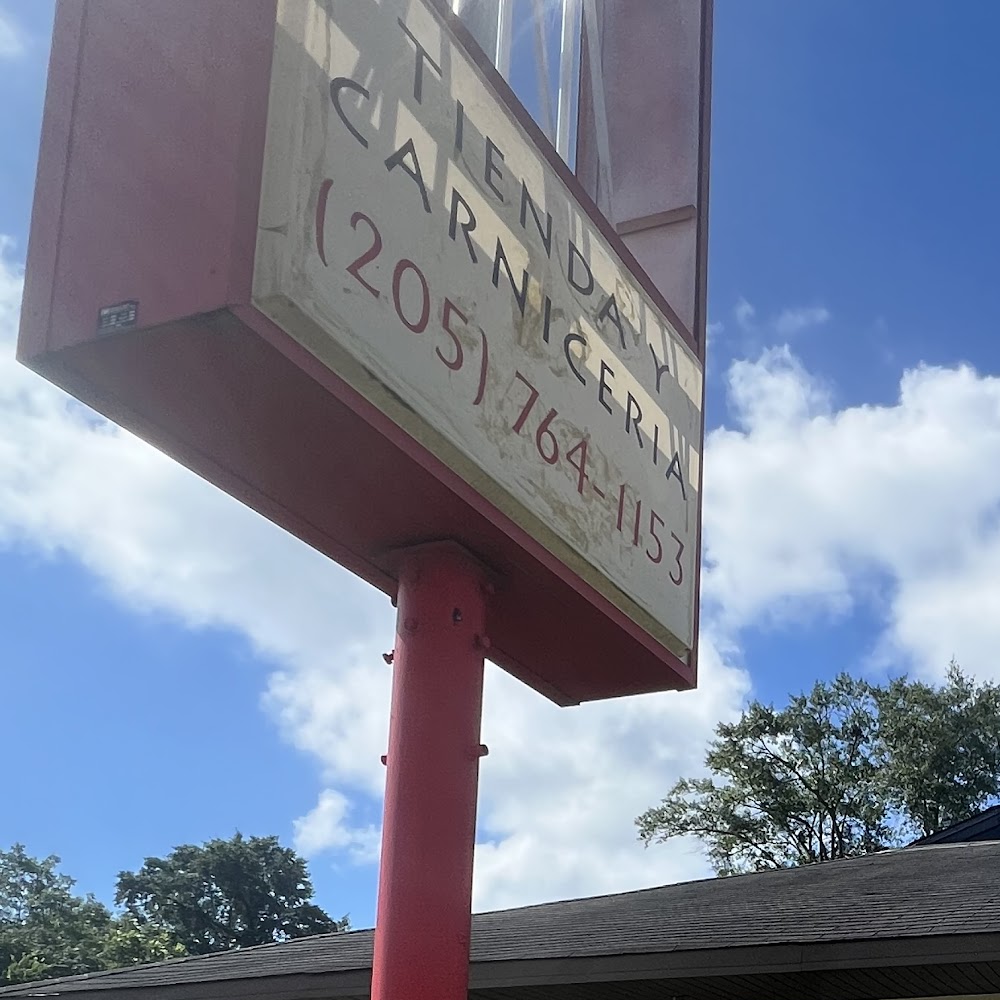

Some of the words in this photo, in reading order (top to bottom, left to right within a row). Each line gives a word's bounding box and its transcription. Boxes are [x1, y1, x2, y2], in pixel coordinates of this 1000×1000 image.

[315, 179, 489, 405] (205)
[512, 371, 685, 586] 764-1153
[330, 77, 687, 500] CARNICERIA
[397, 17, 627, 350] TIENDA
[649, 343, 670, 394] Y
